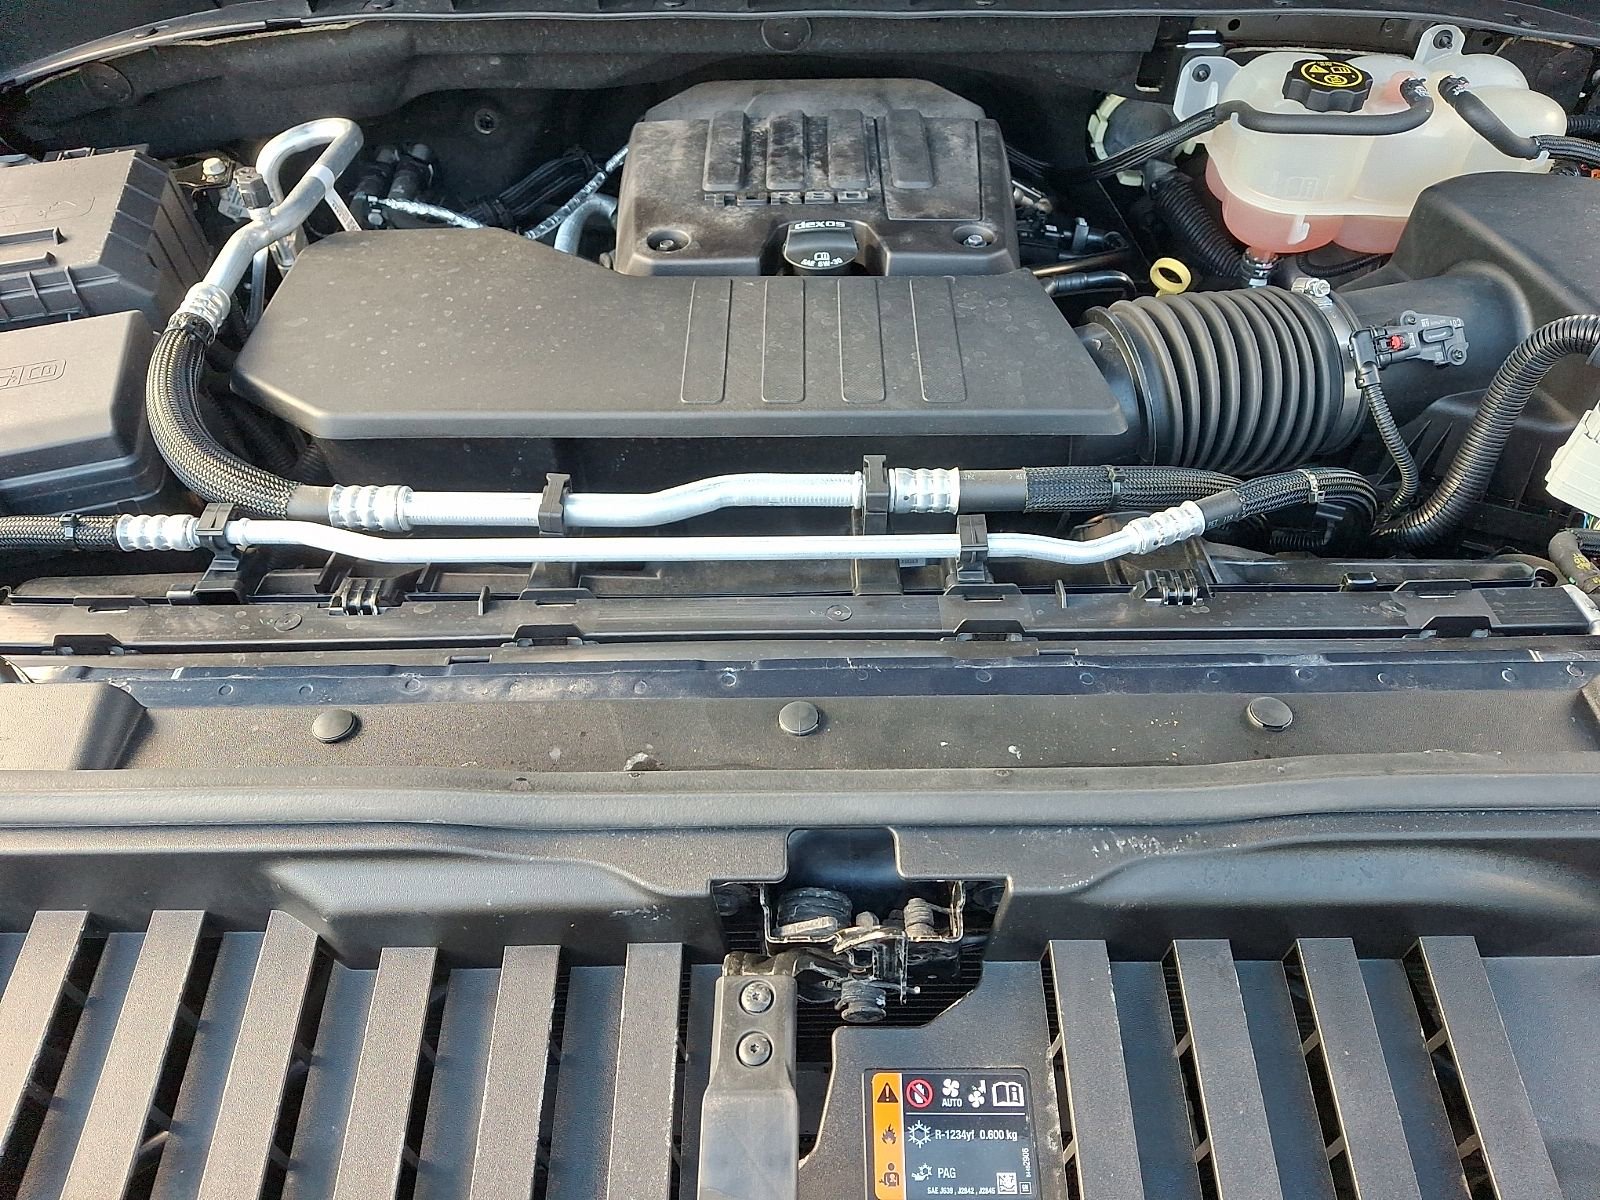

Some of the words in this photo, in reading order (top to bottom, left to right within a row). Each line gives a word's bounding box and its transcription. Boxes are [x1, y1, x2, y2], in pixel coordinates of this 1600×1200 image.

[794, 220, 846, 230] dexos
[800, 258, 816, 267] SAE
[941, 1098, 963, 1107] AUTO
[934, 1129, 975, 1142] R-1234yf
[979, 1129, 1005, 1140] 0.600
[1005, 1129, 1018, 1142] kg
[937, 1167, 957, 1179] PAG
[927, 1187, 939, 1195] SAE
